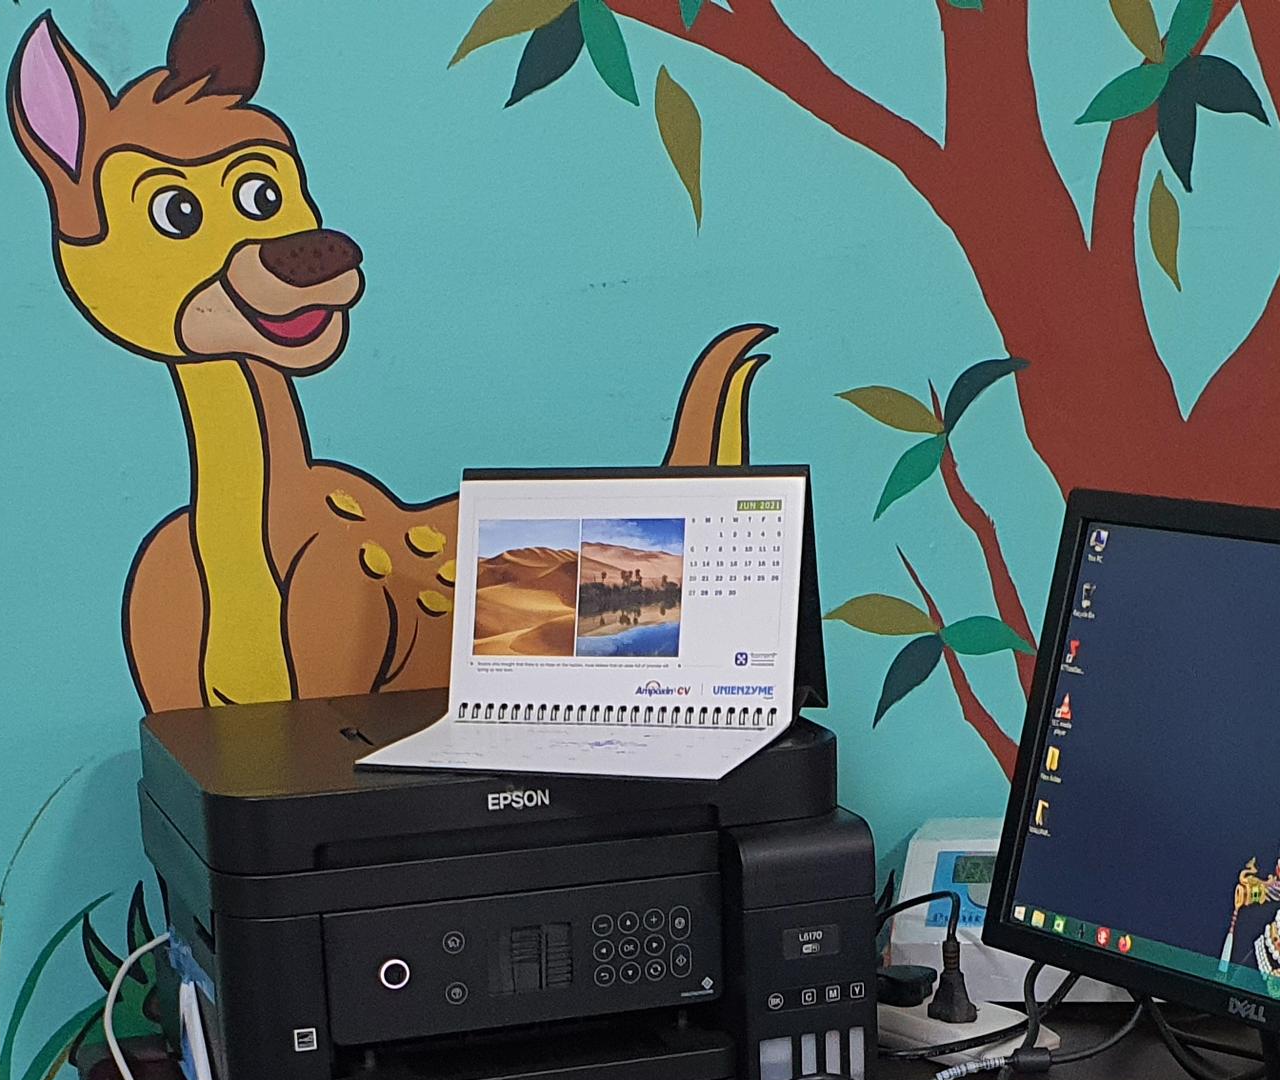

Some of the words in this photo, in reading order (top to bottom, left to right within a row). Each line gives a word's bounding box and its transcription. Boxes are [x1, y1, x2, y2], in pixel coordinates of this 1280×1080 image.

[740, 501, 756, 511] JUN
[760, 501, 780, 510] 2021
[677, 686, 691, 695] CV
[713, 685, 774, 695] UNIENZYME
[487, 788, 550, 811] EPSON
[799, 930, 823, 942] L6170
[1228, 996, 1266, 1023] DELL
